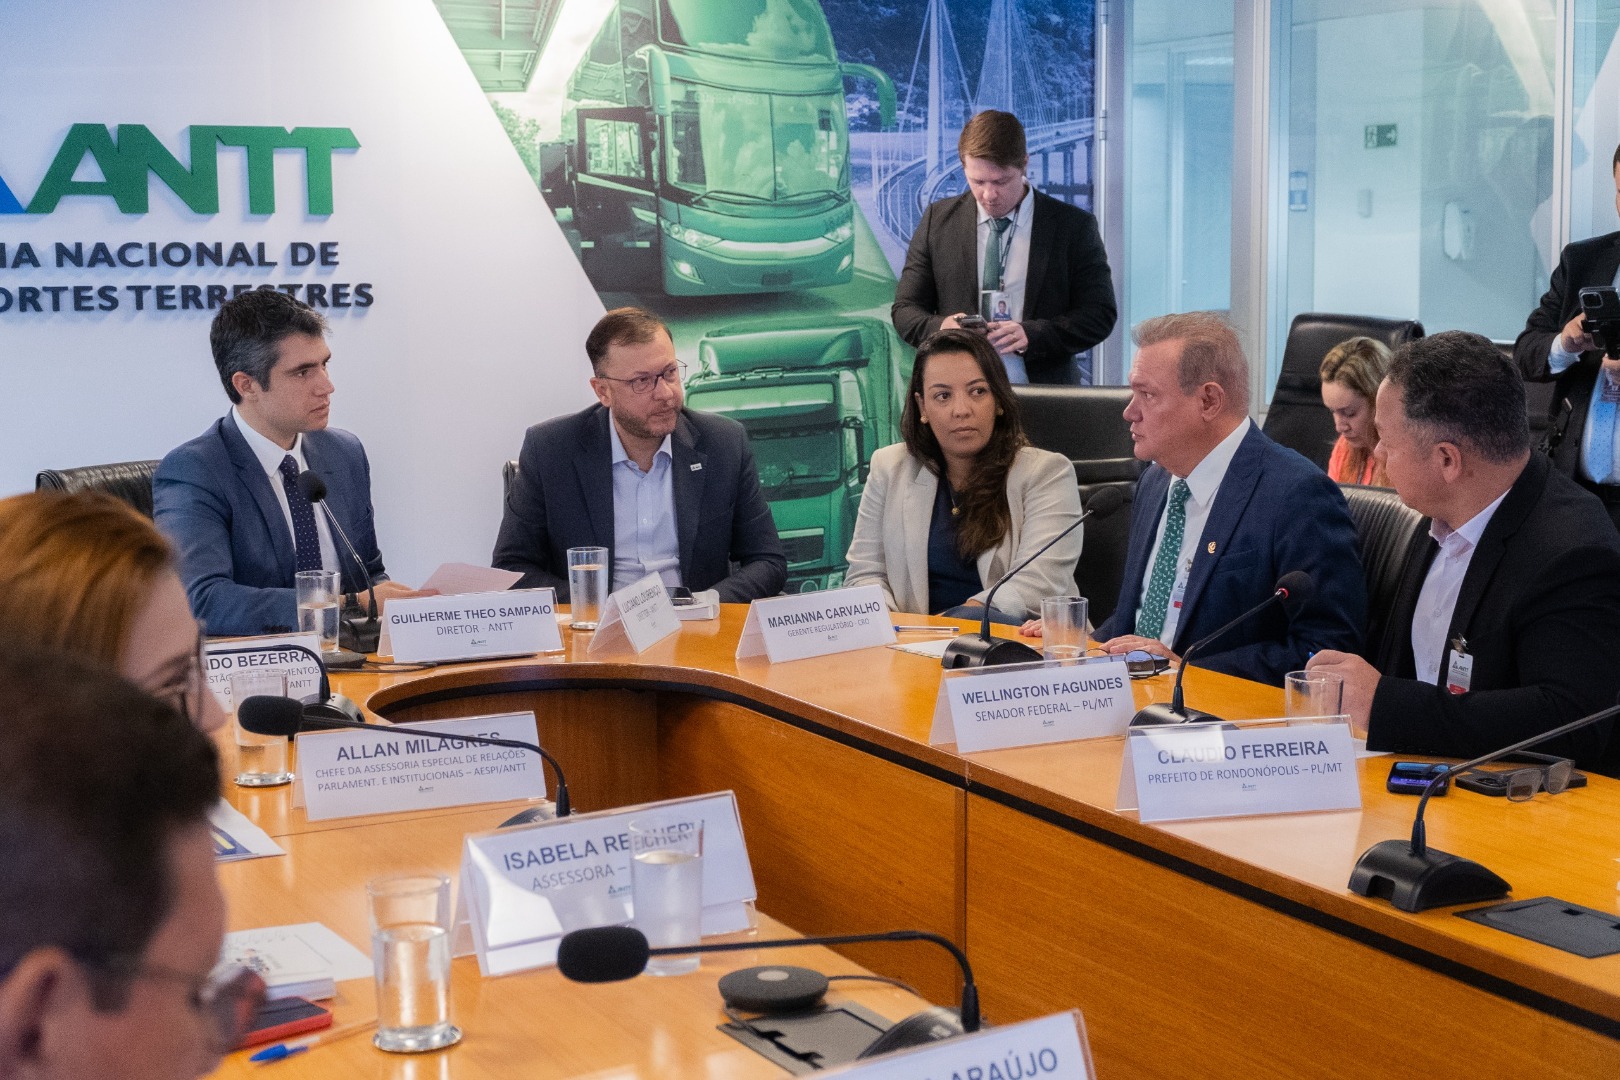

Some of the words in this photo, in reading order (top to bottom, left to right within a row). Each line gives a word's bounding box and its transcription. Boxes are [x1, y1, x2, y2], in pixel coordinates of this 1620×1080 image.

[26, 123, 361, 214] ANTT
[55, 242, 277, 268] NACIONAL
[290, 242, 339, 266] DE
[126, 283, 374, 311] TERRTRES
[391, 610, 462, 625] GUILHERME
[464, 608, 496, 620] THEO
[499, 604, 551, 618] SAMPAIO
[767, 610, 824, 628] MARIANNA
[825, 601, 881, 619] CARVALHO
[436, 624, 479, 635] DIRETOR
[488, 622, 514, 632] ANTT
[787, 626, 814, 637] GERENTE
[238, 651, 311, 668] BEZERRA
[287, 680, 312, 688] ANTT
[962, 684, 1050, 705] WELLINGTON
[1053, 676, 1123, 695] FAGUNDES
[975, 707, 1026, 722] SENADOR
[1028, 702, 1072, 716] FEDERAL
[1082, 697, 1114, 711] PL/MT
[336, 741, 400, 761] ALLAN
[1241, 740, 1330, 760] FERREIRA
[315, 767, 346, 778] CHEFE
[348, 765, 362, 776] DA
[364, 760, 420, 774] ASSESSORIA
[422, 756, 464, 768] ESPECIAL
[466, 754, 478, 763] DE
[480, 749, 526, 762] RELAÇÕES
[1148, 771, 1197, 784] PREFEITO
[1200, 770, 1215, 781] DE
[1217, 764, 1300, 780] RONDONÓPOLIS
[1311, 762, 1342, 775] PL/MT
[318, 777, 380, 792] PARLAMENT.
[382, 777, 387, 786] E
[389, 769, 464, 784] INSTITUCIONAIS
[474, 762, 527, 776] AESPI/ANTT
[504, 839, 600, 871] ISABELA
[532, 863, 615, 891] ASSESSORA
